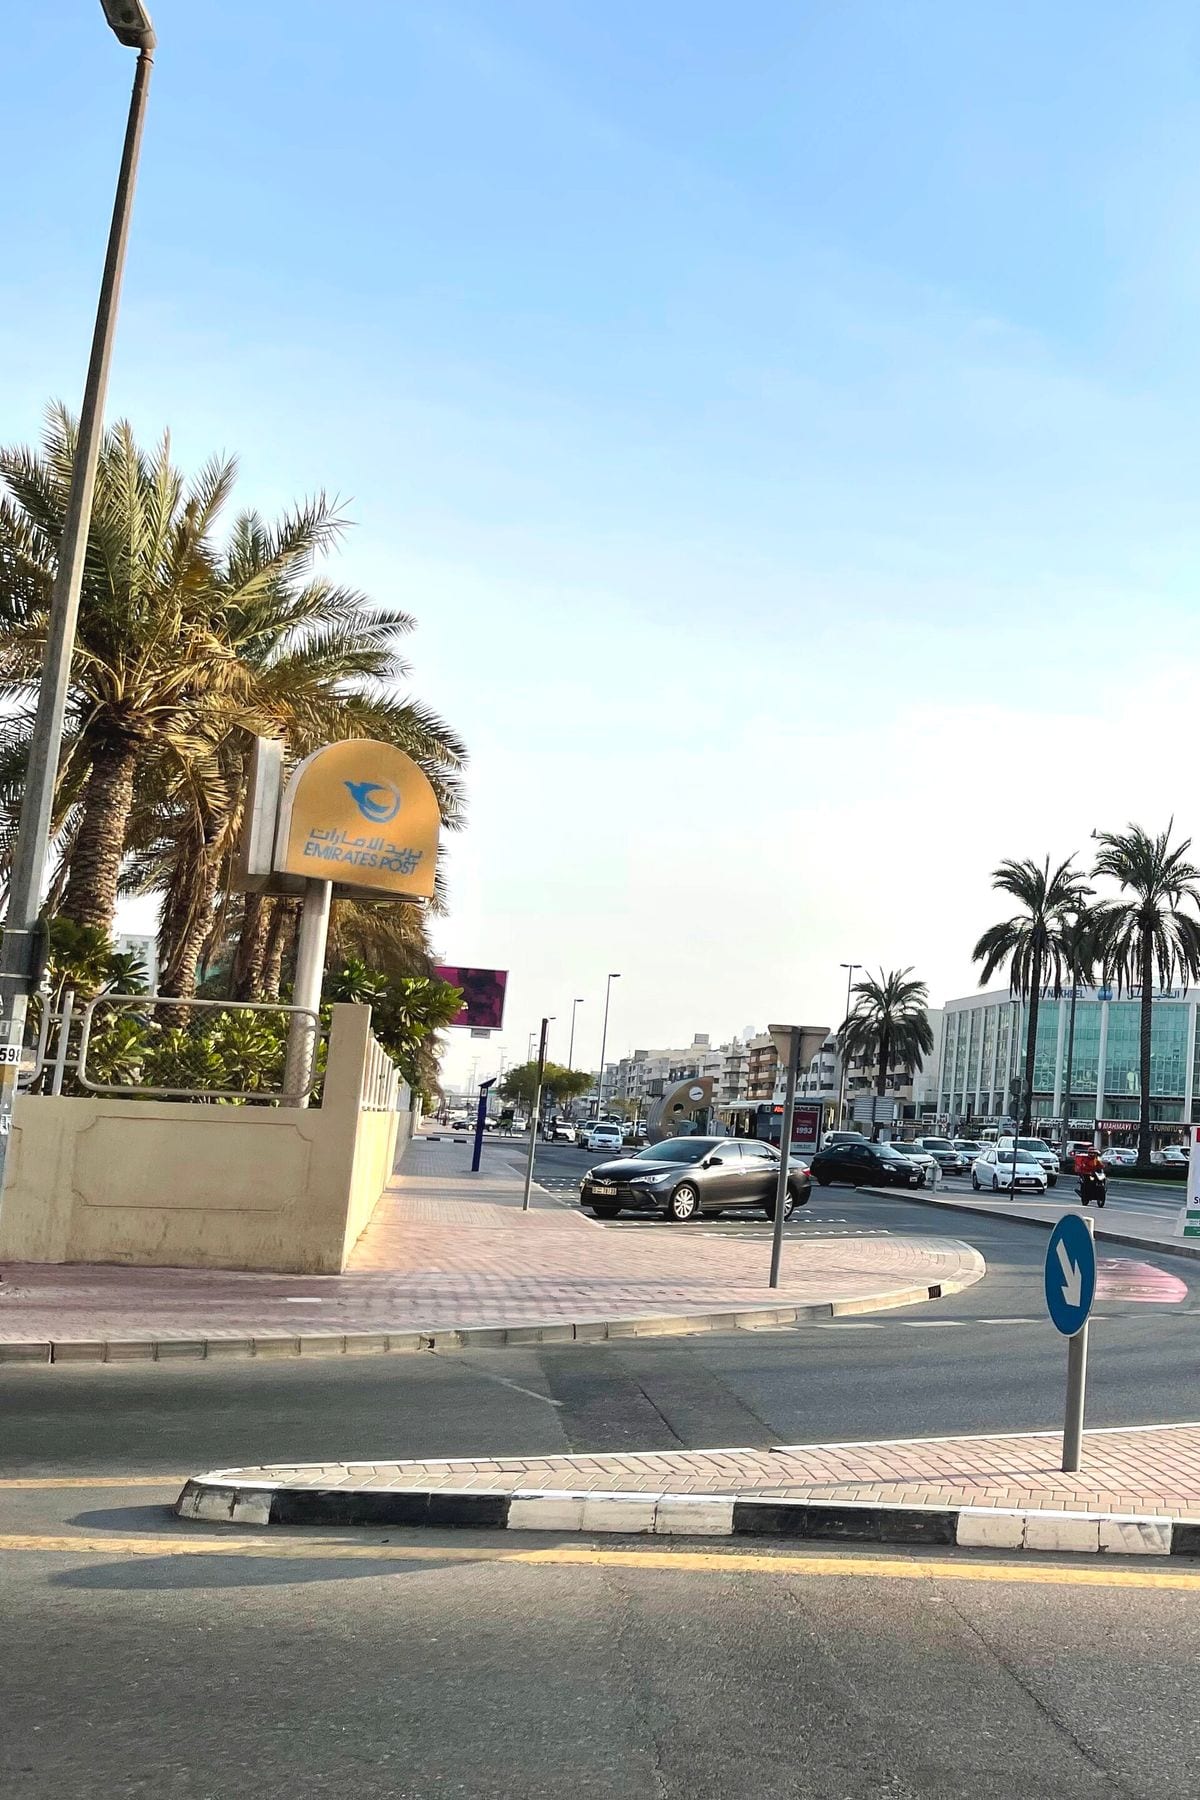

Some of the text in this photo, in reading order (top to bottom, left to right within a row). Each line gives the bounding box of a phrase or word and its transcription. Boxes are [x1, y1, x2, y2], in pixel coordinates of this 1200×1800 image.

[303, 841, 419, 876] EMIRATES POST
[796, 1127, 813, 1135] 1993
